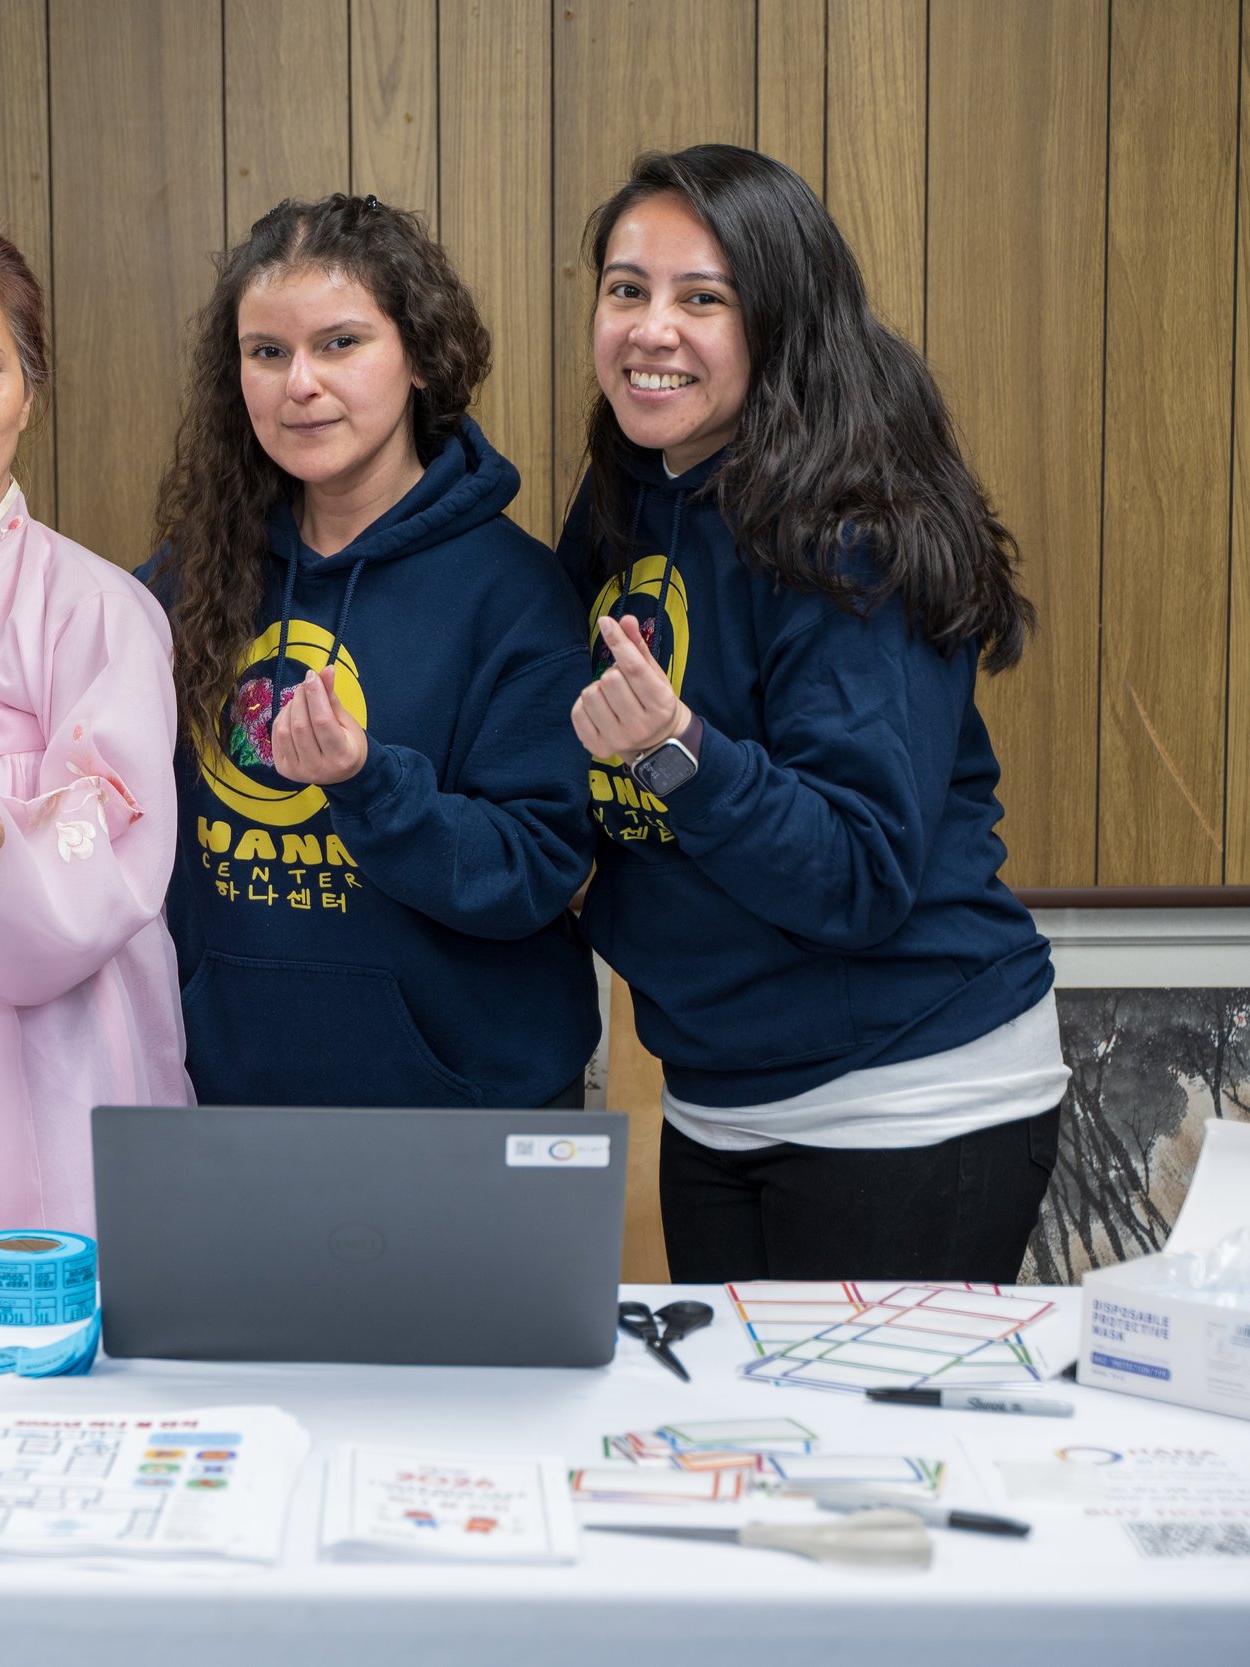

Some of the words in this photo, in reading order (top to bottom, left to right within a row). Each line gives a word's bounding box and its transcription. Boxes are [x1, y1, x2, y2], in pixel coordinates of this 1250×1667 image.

[202, 851, 363, 889] CENTER
[215, 879, 347, 913] 하나센터
[1092, 1299, 1169, 1328] DISPOSABLE
